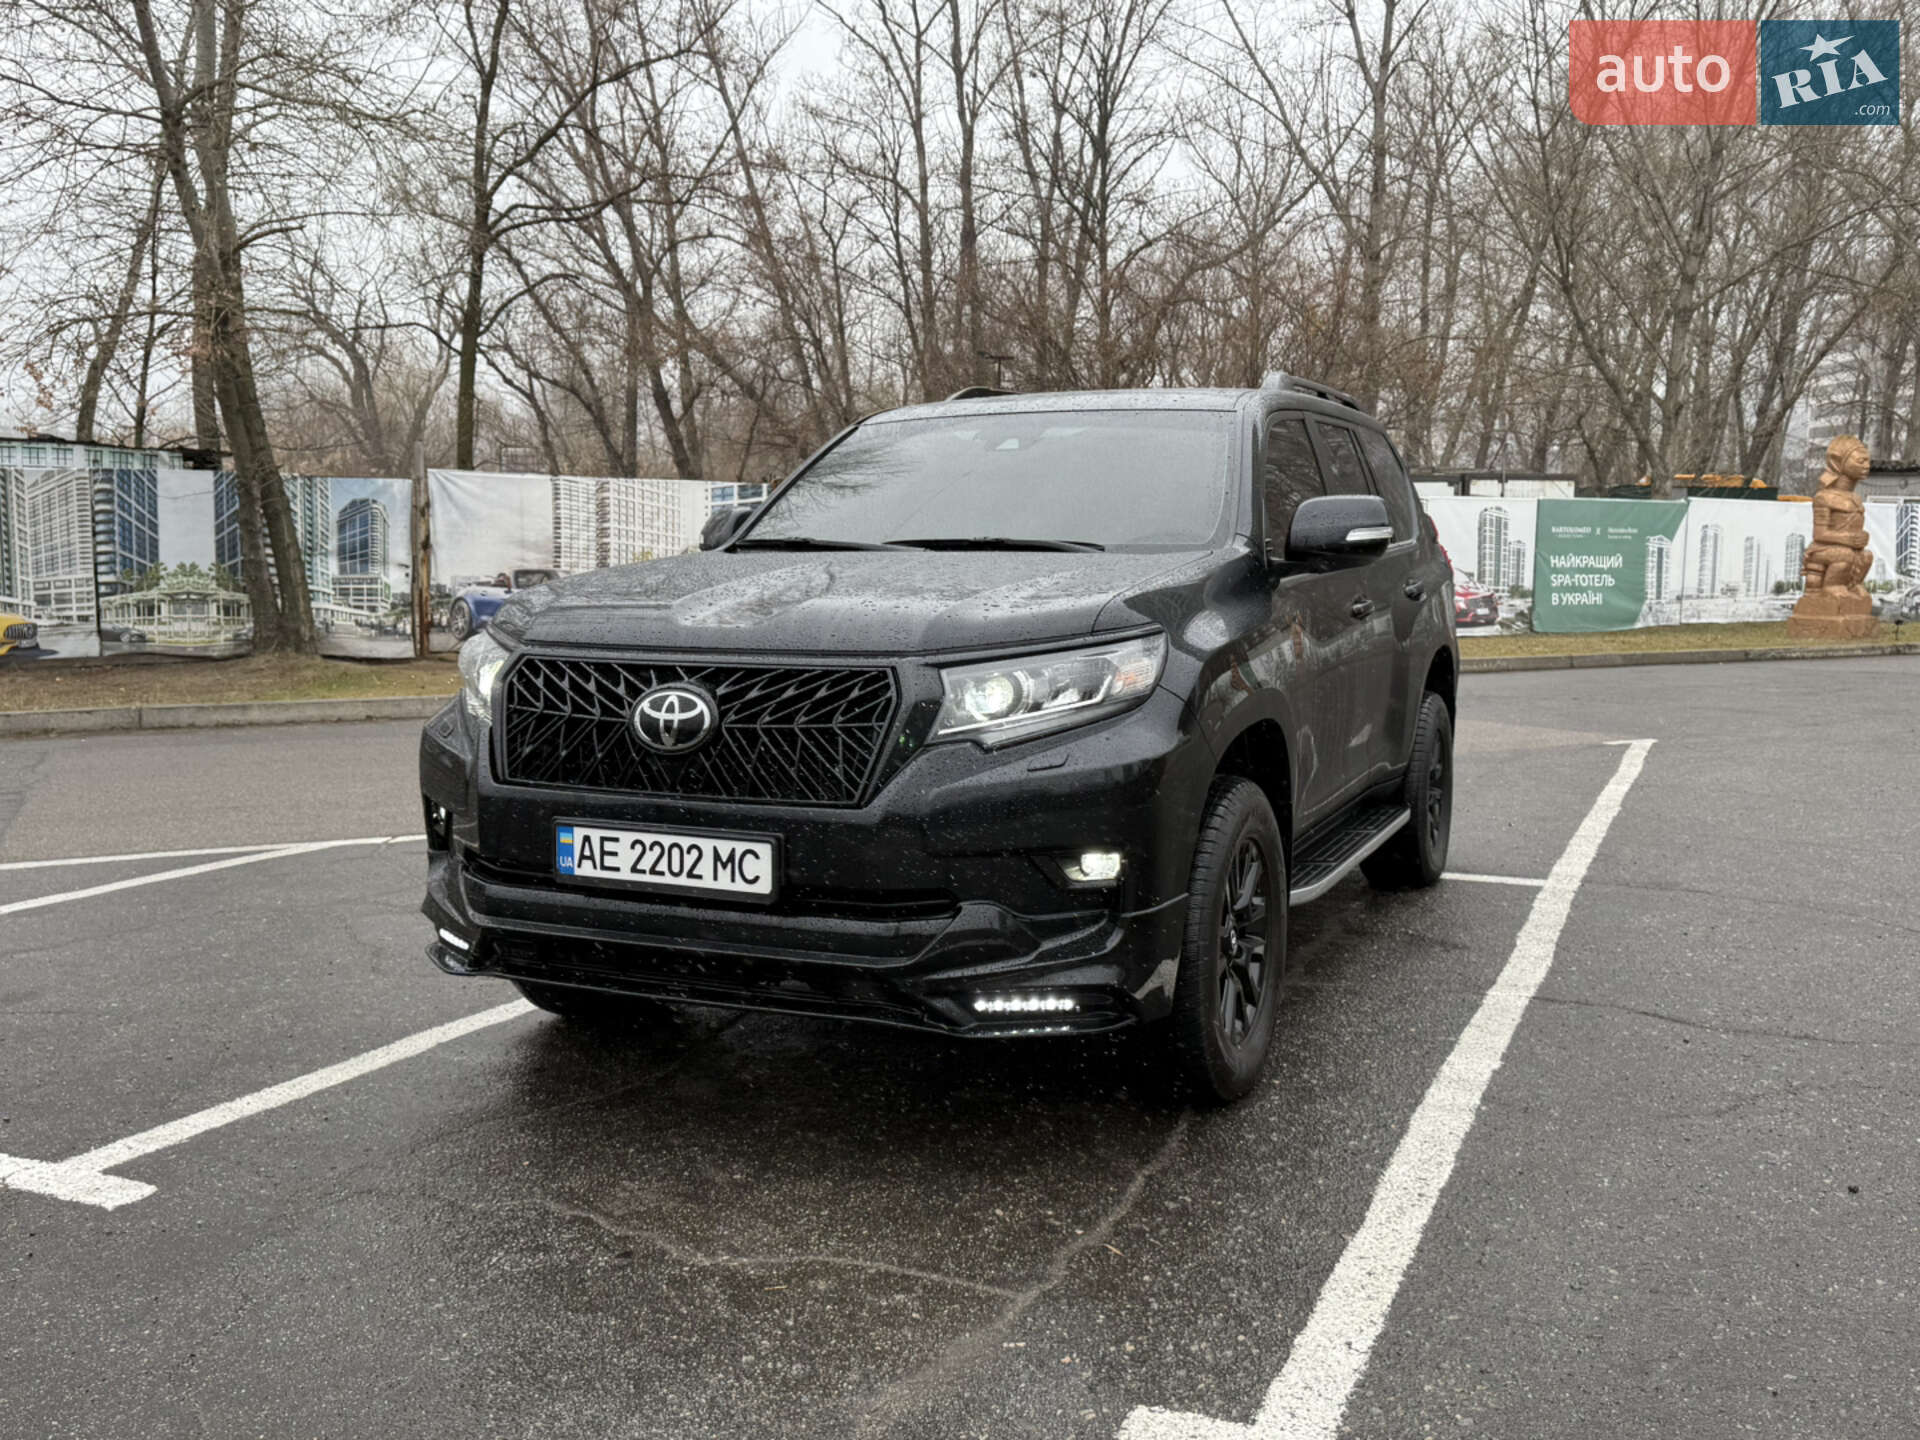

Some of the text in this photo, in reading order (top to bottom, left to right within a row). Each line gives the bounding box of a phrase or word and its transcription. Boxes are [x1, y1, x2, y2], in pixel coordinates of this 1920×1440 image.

[1550, 553, 1623, 571] НАЙКРАЩИЙ
[1551, 574, 1616, 587] SPA-ГОТЕЛЬ
[1551, 590, 1603, 606] В УКРАЇНІ
[577, 834, 761, 885] AE 2202 MC
